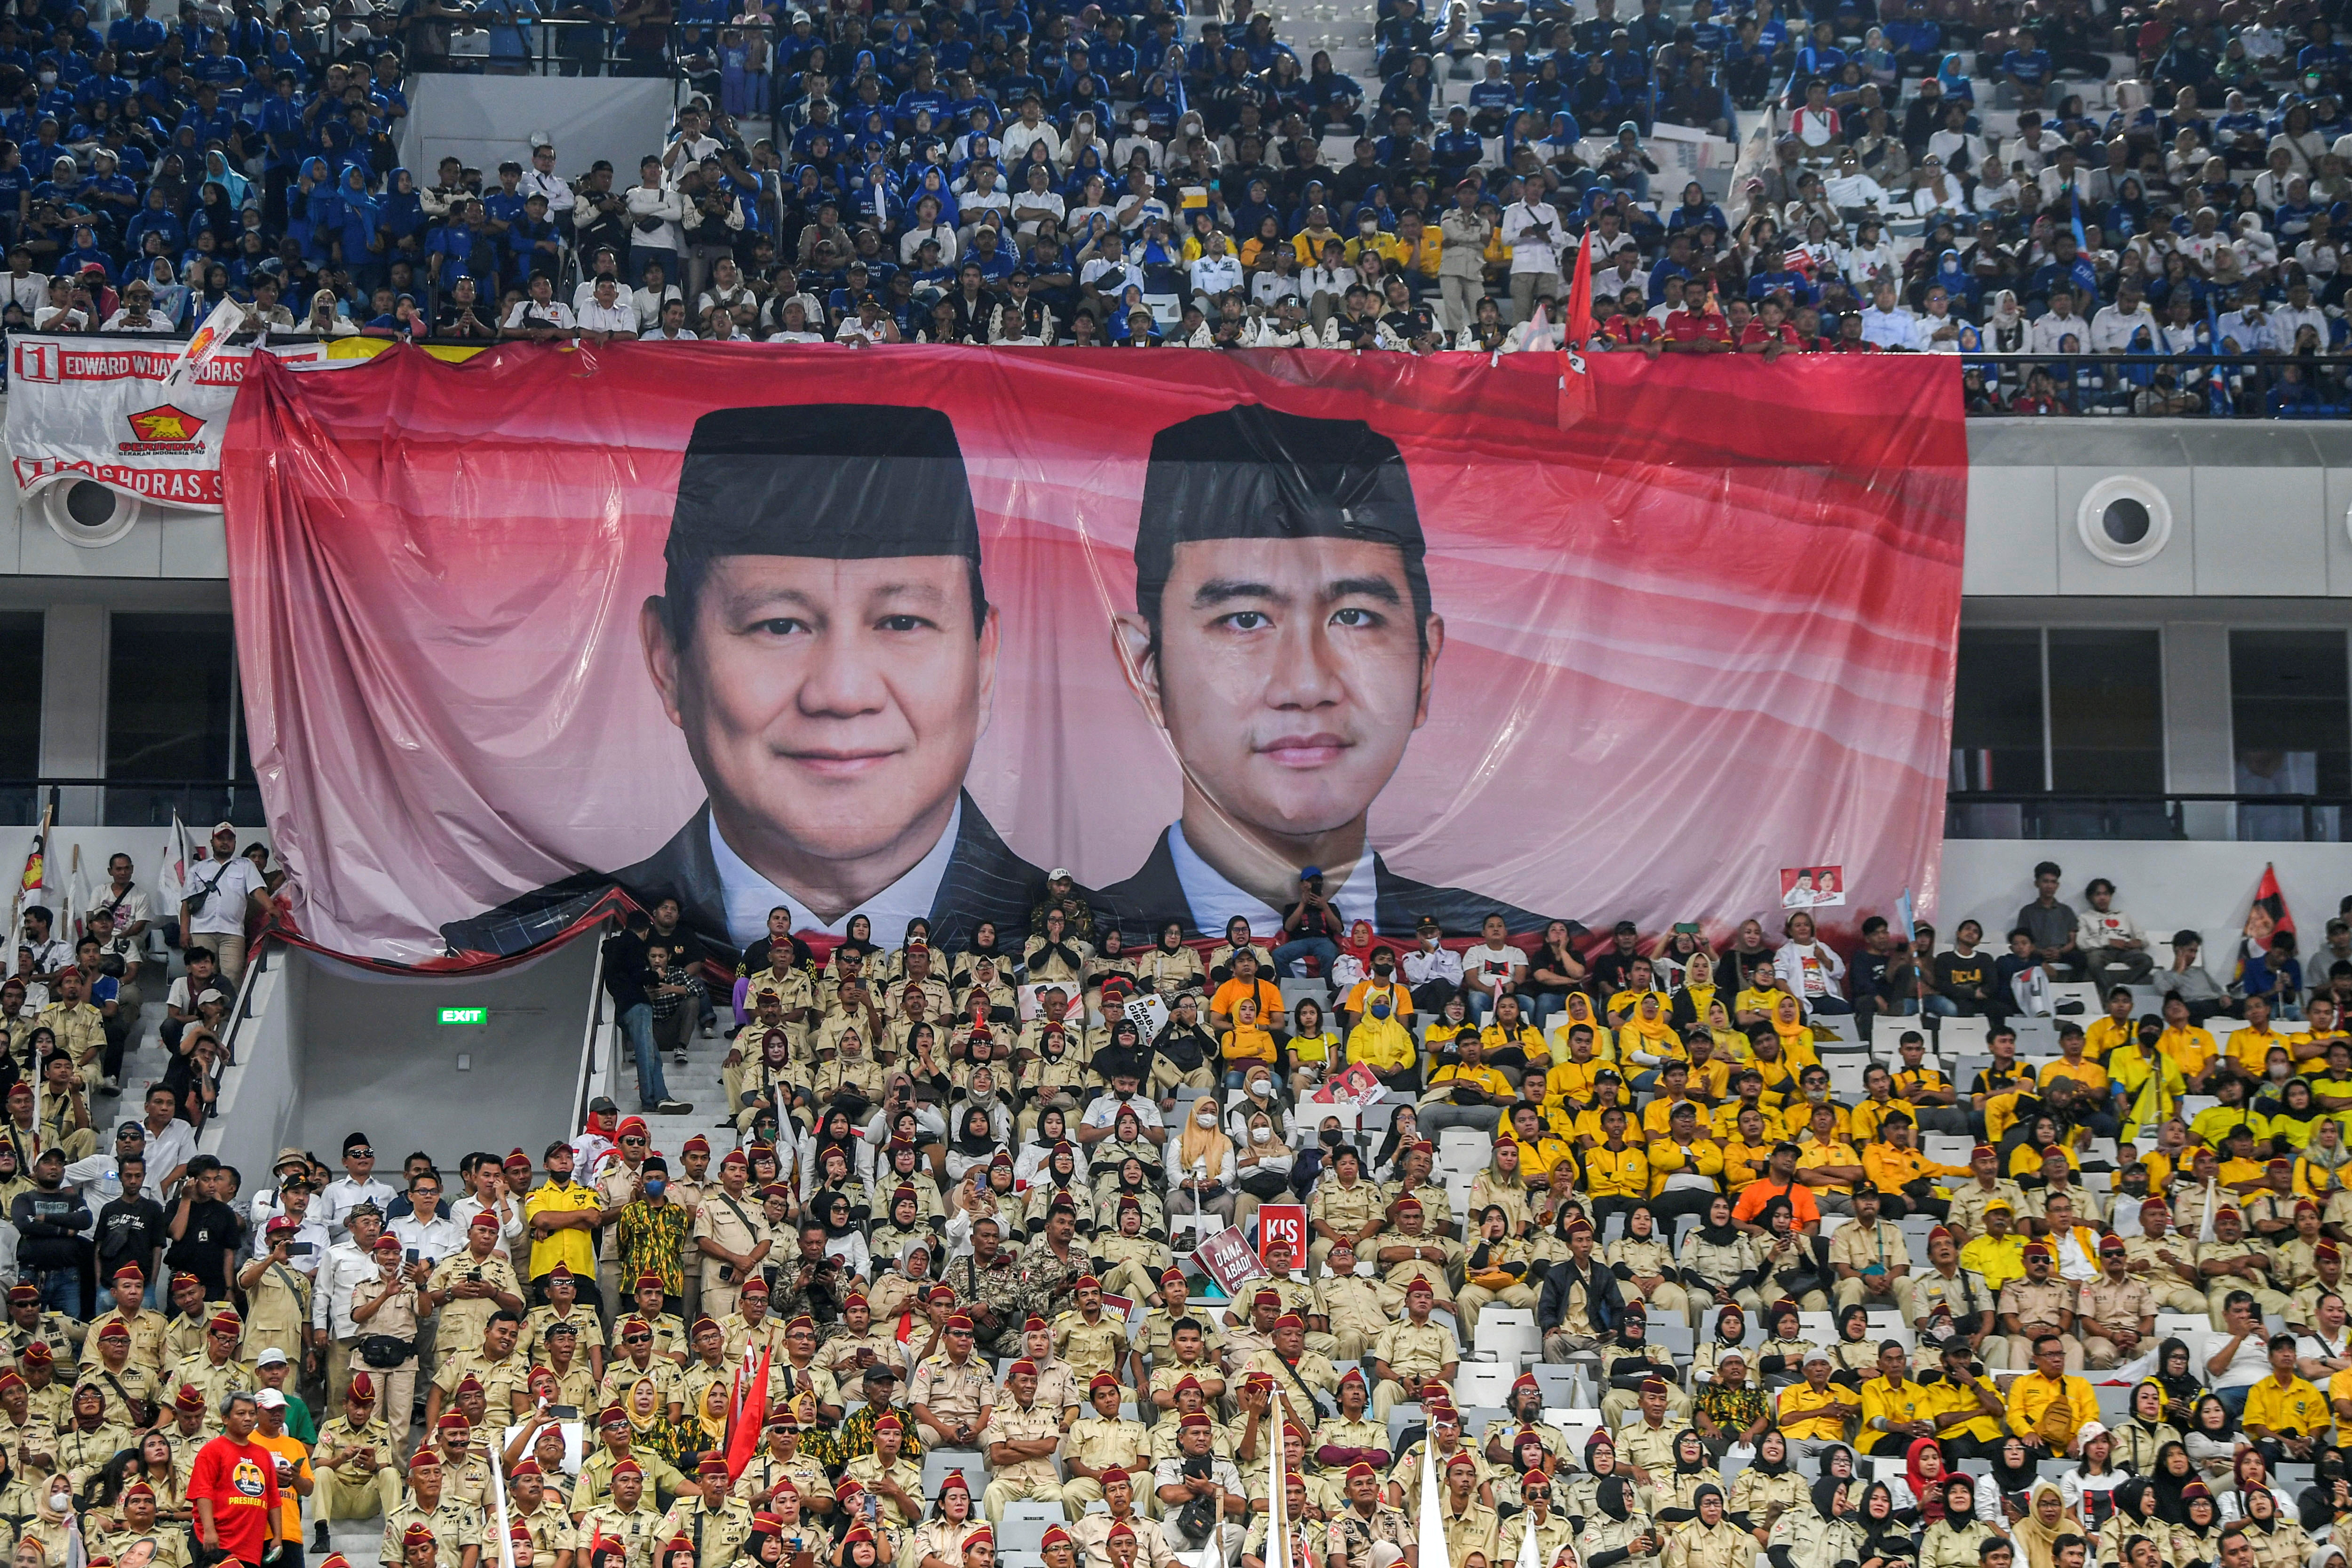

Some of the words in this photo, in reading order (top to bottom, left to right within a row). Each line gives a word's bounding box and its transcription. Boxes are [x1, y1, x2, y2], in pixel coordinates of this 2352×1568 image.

[27, 346, 54, 380] 1
[65, 356, 130, 376] EDWARD
[132, 355, 175, 377] WIJAY
[197, 361, 243, 382] ORAS
[119, 440, 206, 452] GERINDRA
[443, 1011, 481, 1021] EXIT
[1357, 1087, 1373, 1106] DUKUNG
[1266, 1219, 1298, 1243] KIS
[1215, 1241, 1243, 1267] DANA
[1224, 1254, 1252, 1281] ABADI
[229, 1496, 262, 1507] PRESIDEN
